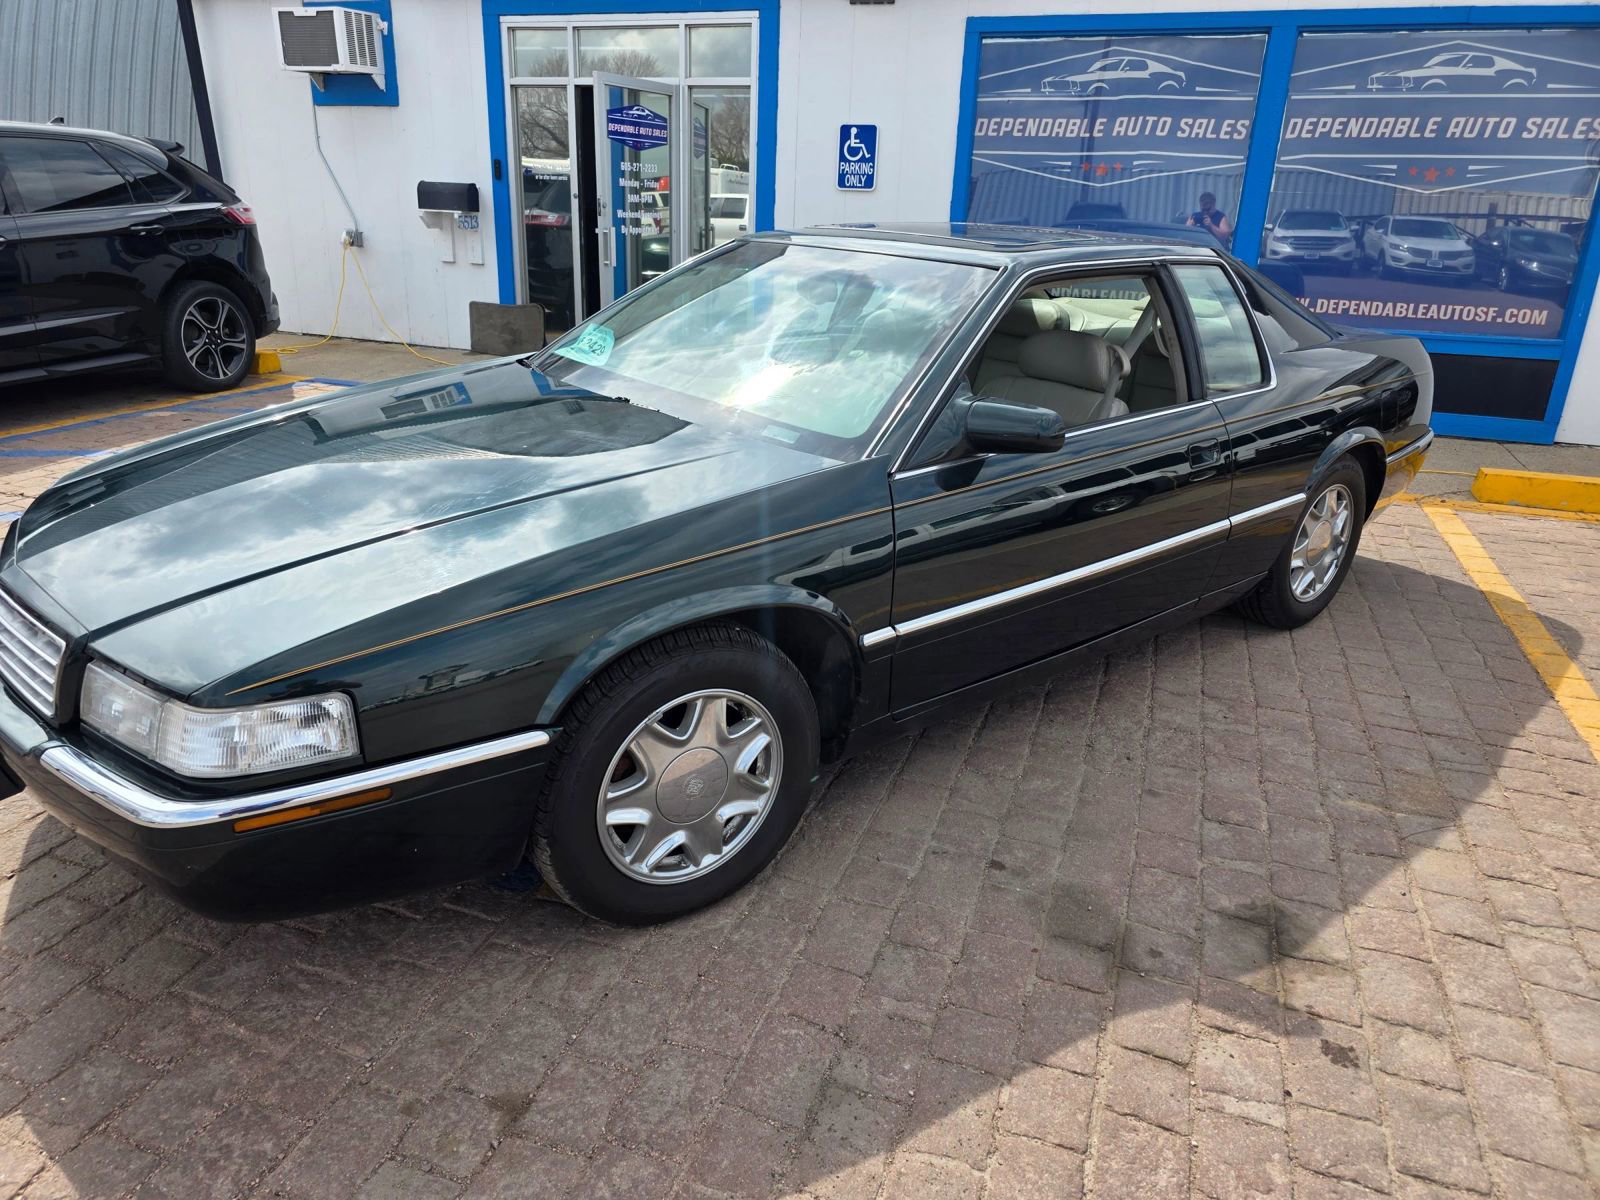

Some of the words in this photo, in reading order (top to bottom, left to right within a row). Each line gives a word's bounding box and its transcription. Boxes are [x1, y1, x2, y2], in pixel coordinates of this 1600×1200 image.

[608, 122, 639, 134] DEPENDABLE
[639, 127, 652, 136] AUTO
[652, 128, 668, 138] SALES
[974, 117, 1107, 137] DEPENDABLE
[1112, 116, 1172, 136] AUTO
[1176, 118, 1250, 140] SALES
[1285, 117, 1442, 139] DEPENDABLE
[1446, 116, 1516, 139] AUTO
[1521, 117, 1600, 139] SALES
[620, 162, 658, 172] 605-271-2233
[839, 162, 874, 175] PARKING
[619, 178, 639, 189] Monday
[644, 179, 660, 191] Friday
[844, 174, 867, 187] ONLY
[457, 214, 480, 230] 5513
